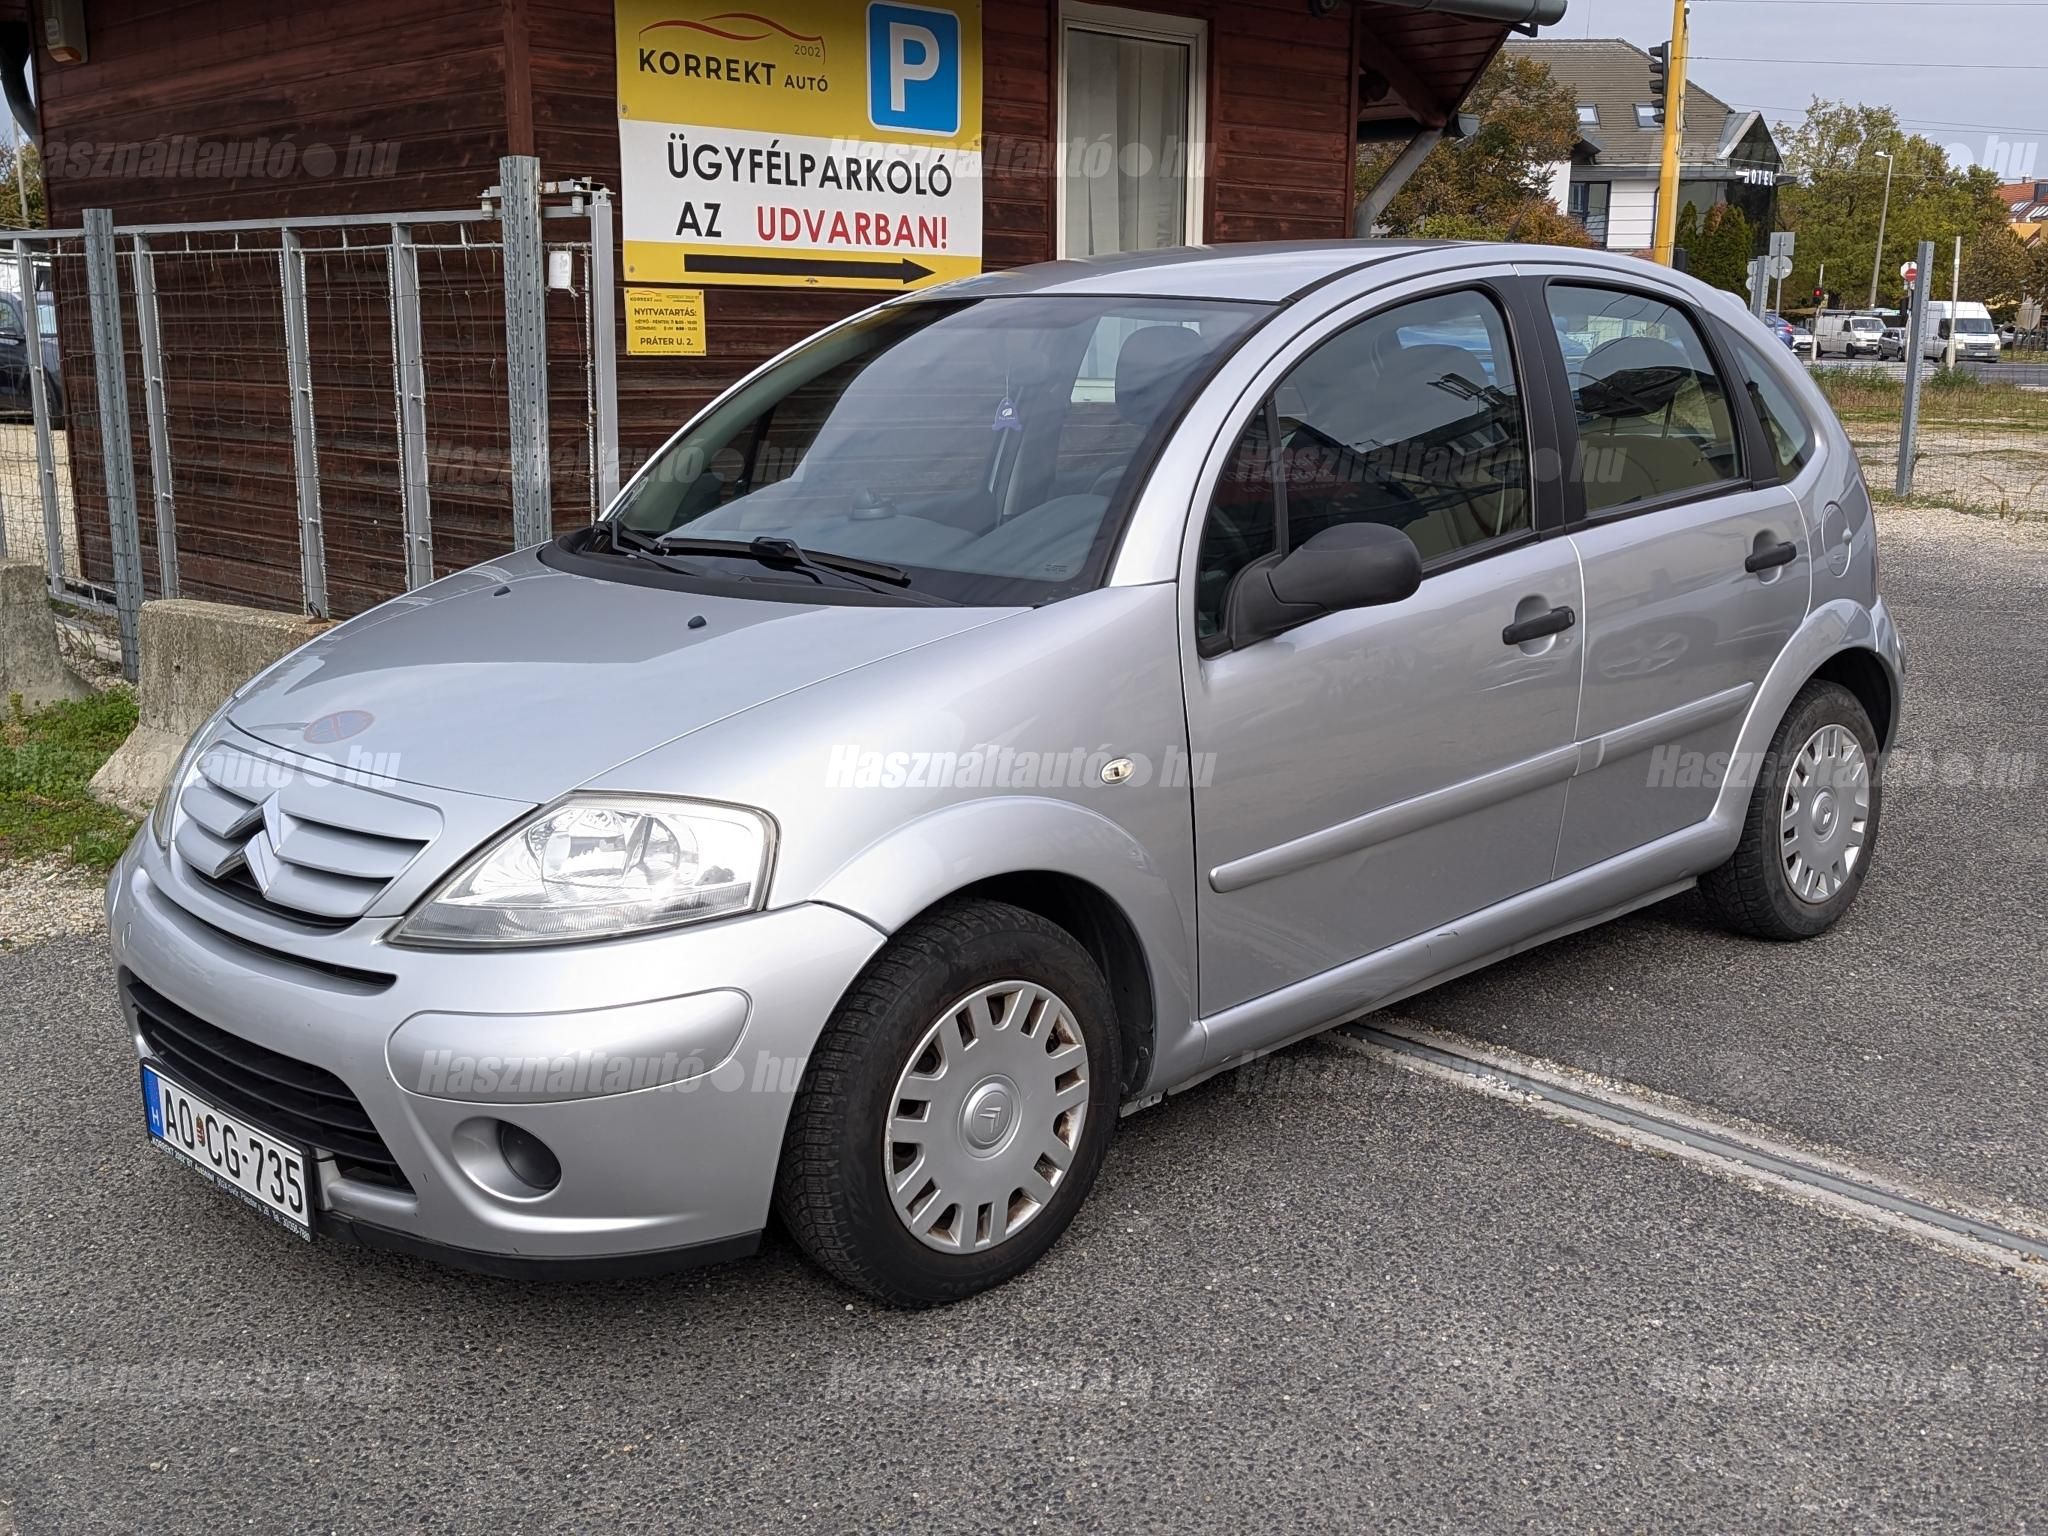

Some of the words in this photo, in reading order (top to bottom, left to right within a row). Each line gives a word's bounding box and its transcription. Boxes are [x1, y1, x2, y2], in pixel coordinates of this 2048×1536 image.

[794, 43, 821, 58] 2002
[889, 21, 940, 113] P
[638, 48, 776, 86] KORREKT
[784, 75, 829, 93] AUTÓ
[667, 132, 952, 197] ÜGYFÉLPARKOLÓ
[675, 201, 722, 239] AZ
[756, 205, 948, 250] UDVARBAN!
[634, 306, 697, 317] NYITVATARTÁS:
[640, 336, 675, 346] PRÁTER
[676, 337, 685, 346] U.
[686, 337, 694, 346] 2.
[151, 1106, 161, 1128] H
